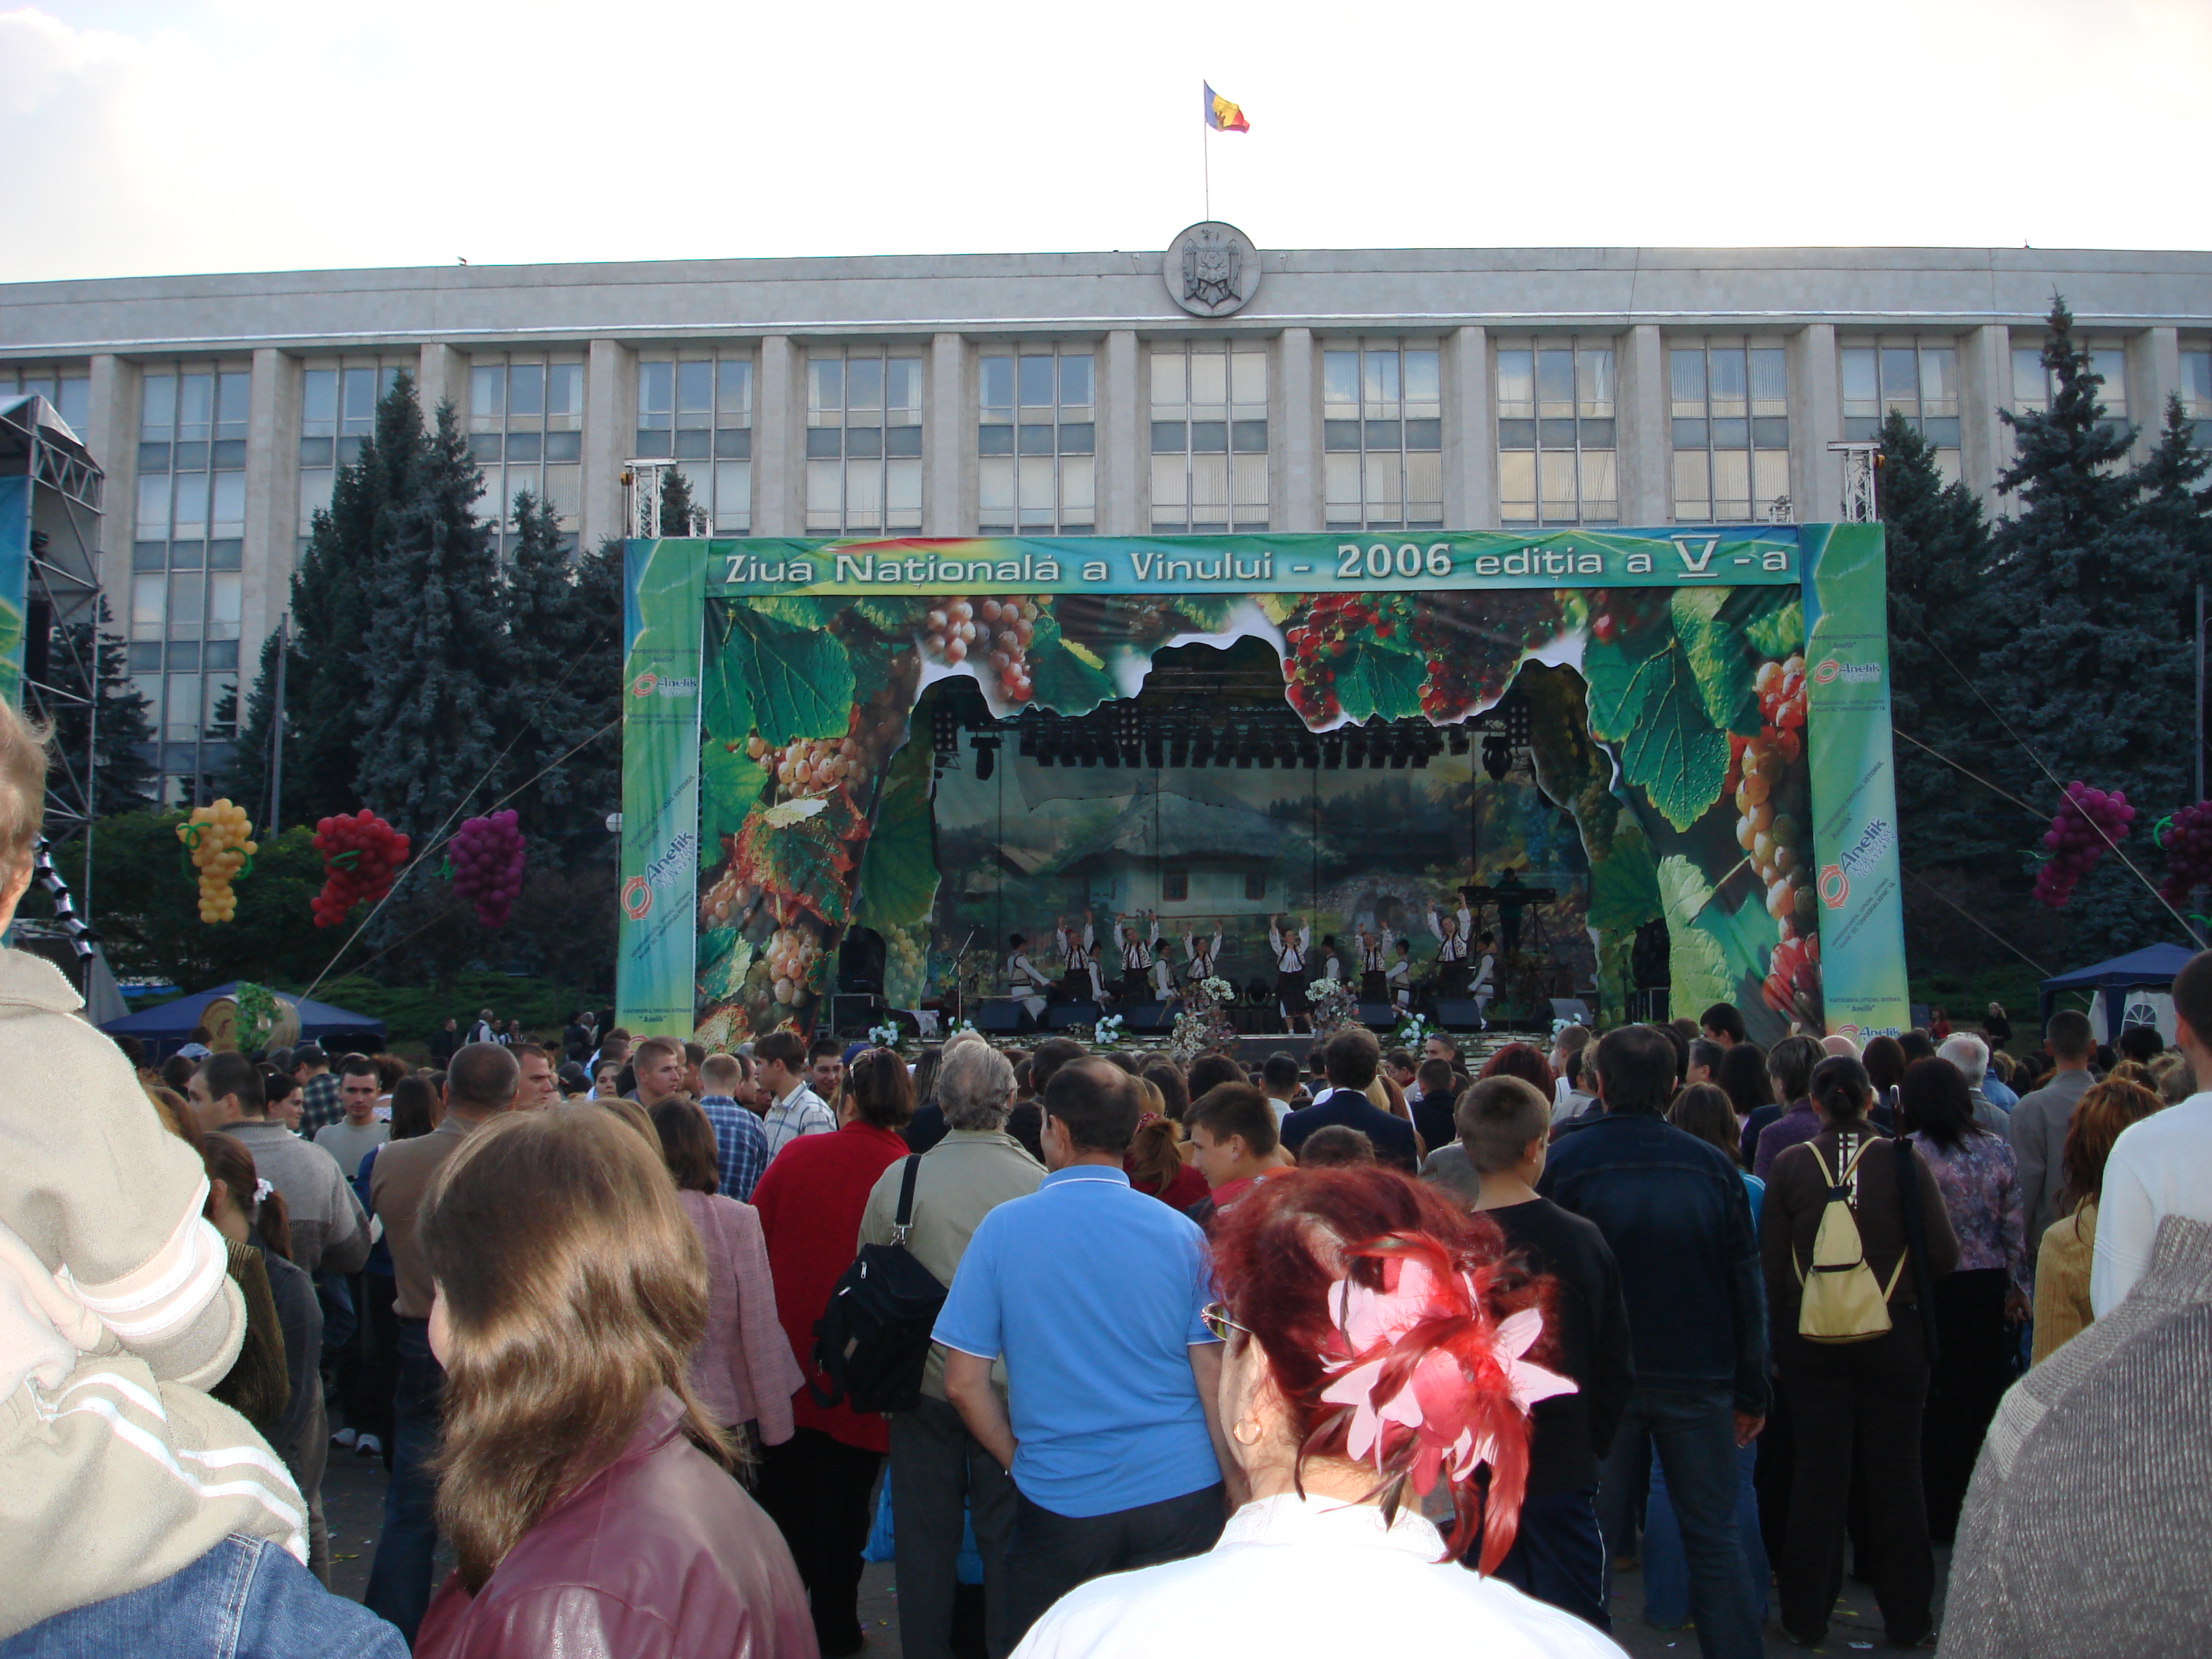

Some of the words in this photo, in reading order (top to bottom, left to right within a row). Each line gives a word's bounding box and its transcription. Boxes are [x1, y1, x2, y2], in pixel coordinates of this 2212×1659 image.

[726, 554, 813, 583] Ziua
[1083, 560, 1107, 581] a
[1130, 552, 1272, 581] Vinului
[1337, 544, 1452, 579] 2006
[1626, 553, 1652, 573] a
[1671, 534, 1721, 578] V
[656, 676, 697, 687] Anelik
[1837, 663, 1880, 674] Anelik
[647, 832, 694, 886] Anelik
[1841, 818, 1887, 876] Anelik
[1858, 1026, 1901, 1036] Anelik
